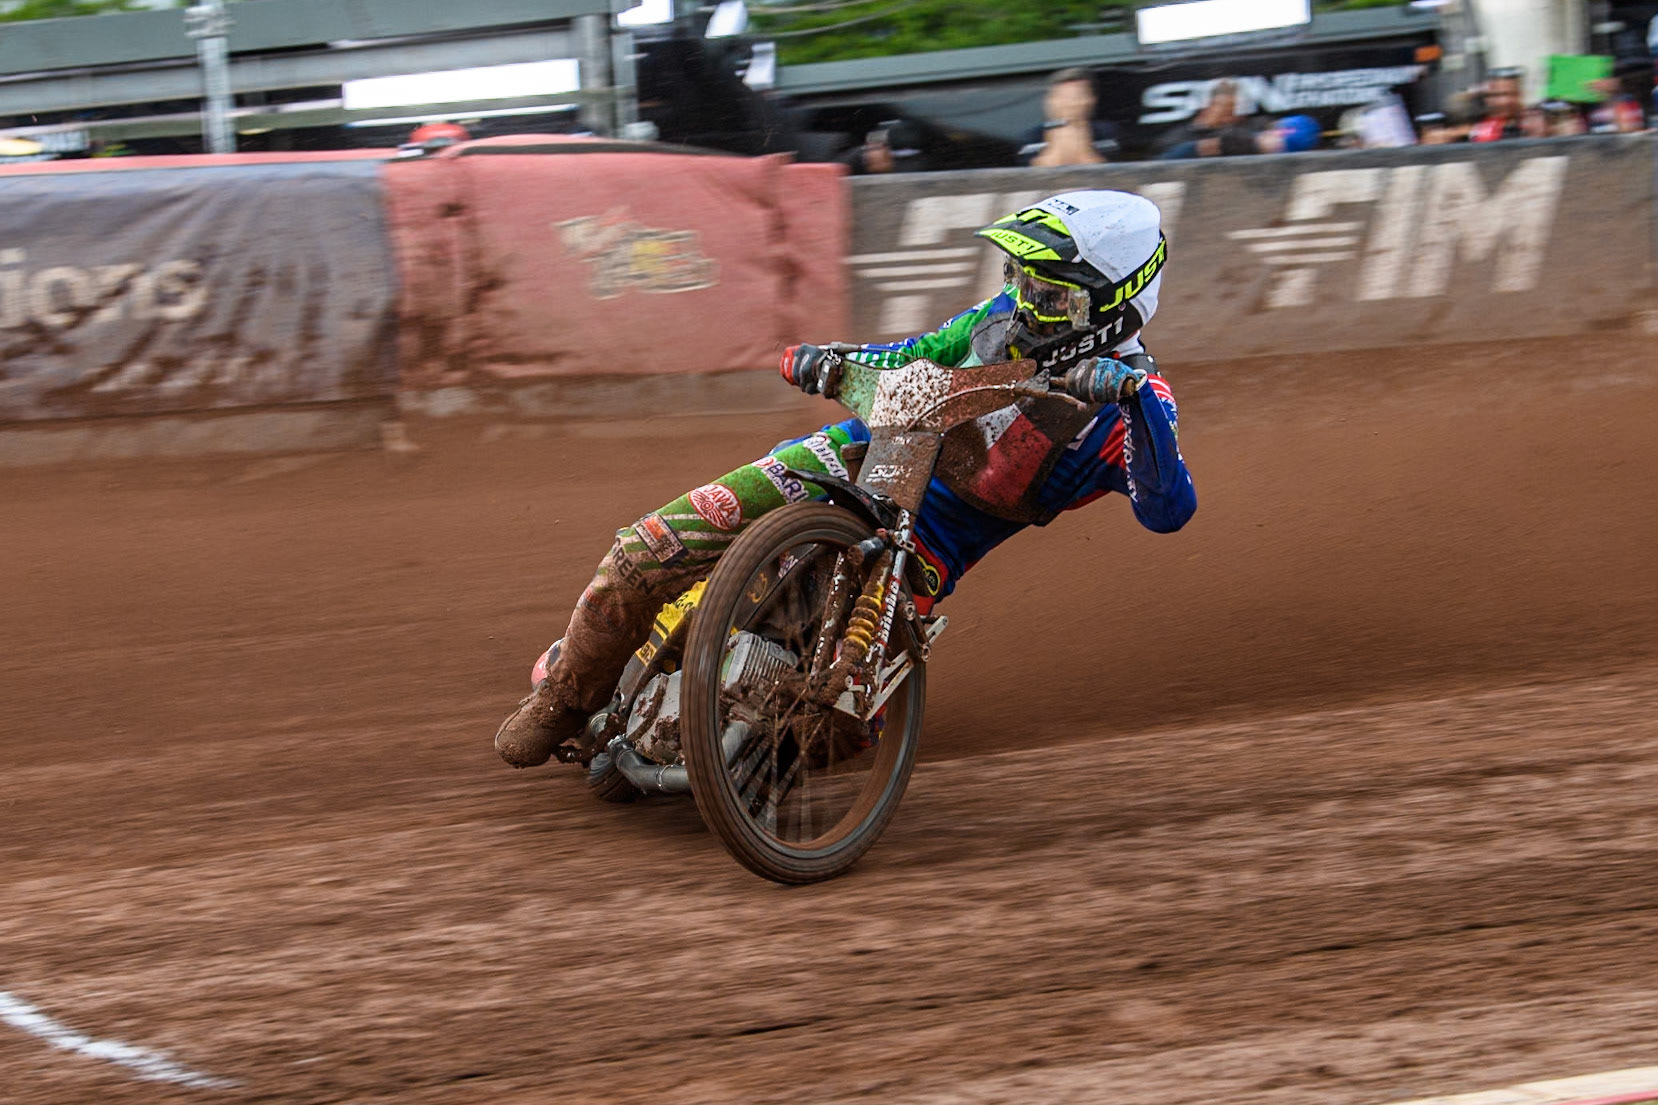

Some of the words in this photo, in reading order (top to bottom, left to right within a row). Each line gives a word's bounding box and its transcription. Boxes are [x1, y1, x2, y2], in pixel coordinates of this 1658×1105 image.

[1228, 156, 1569, 308] FIM
[1041, 315, 1125, 369] JUST1
[704, 484, 738, 521] JAWA
